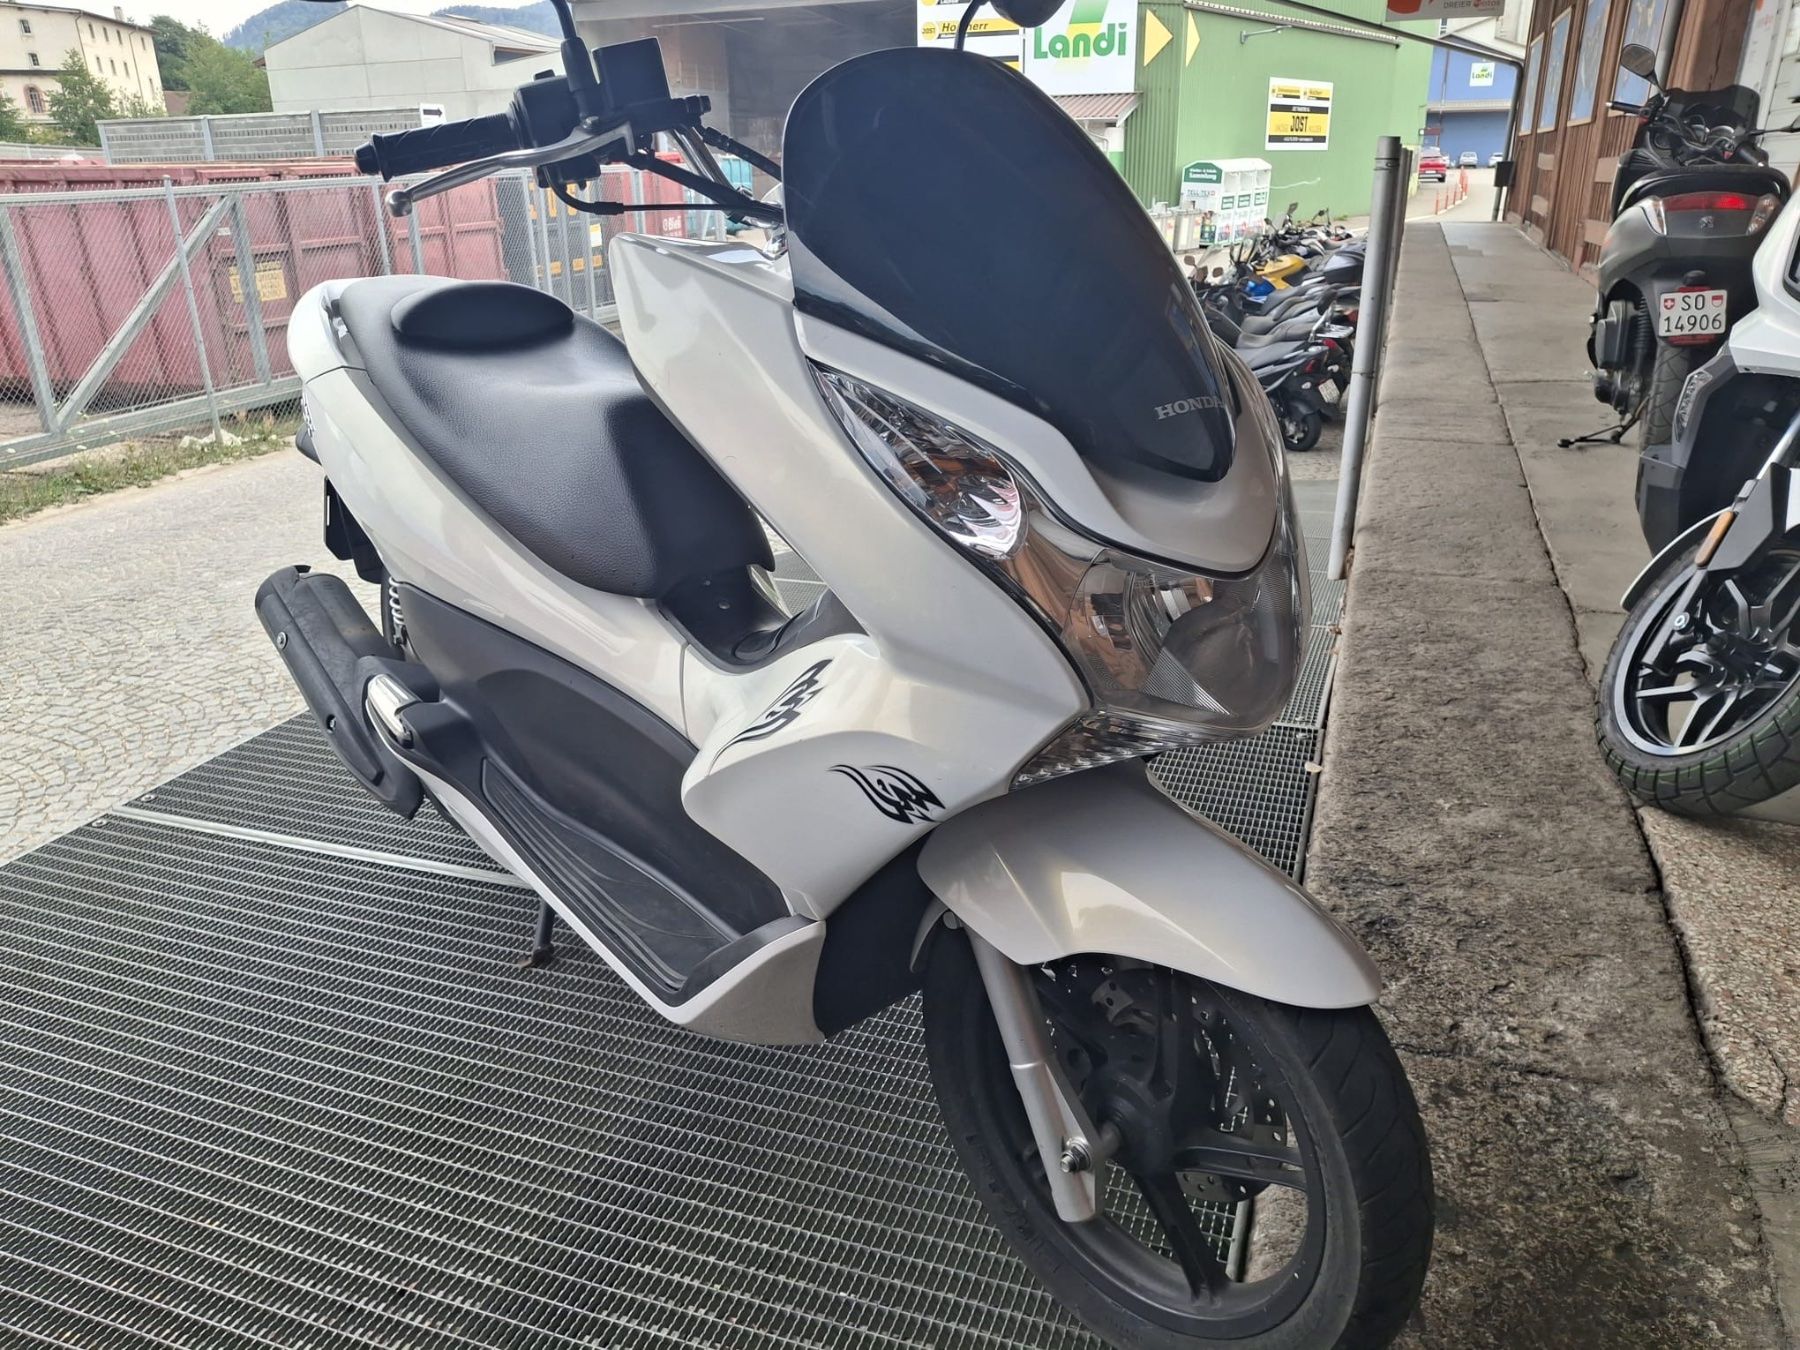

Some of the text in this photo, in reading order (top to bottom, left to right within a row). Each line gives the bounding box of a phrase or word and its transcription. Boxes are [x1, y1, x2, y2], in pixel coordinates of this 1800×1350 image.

[1033, 22, 1128, 60] Landi
[1290, 116, 1308, 132] JOST
[1664, 313, 1722, 333] 14906
[1154, 396, 1225, 420] HONDA
